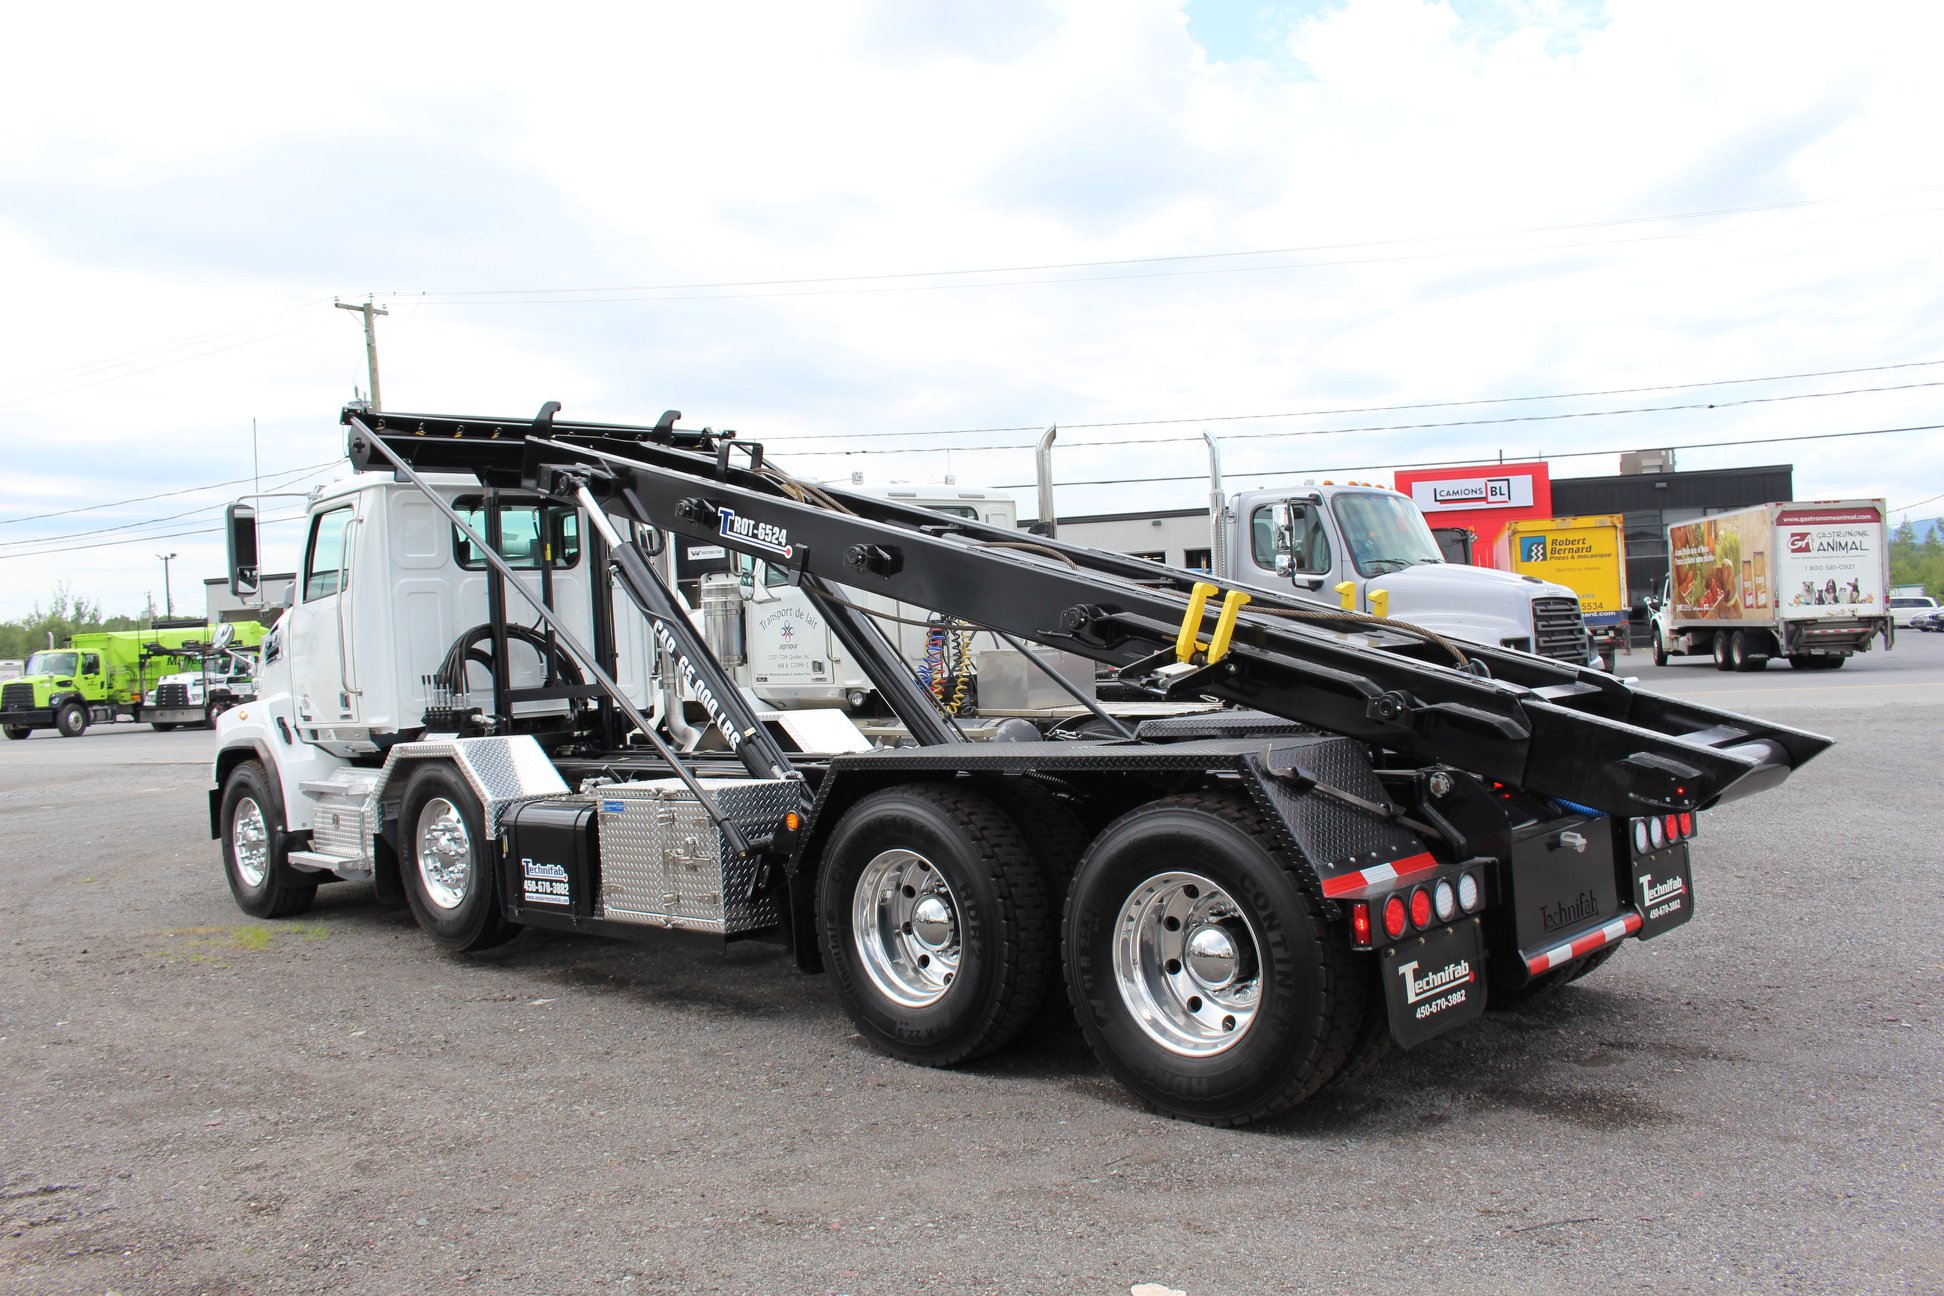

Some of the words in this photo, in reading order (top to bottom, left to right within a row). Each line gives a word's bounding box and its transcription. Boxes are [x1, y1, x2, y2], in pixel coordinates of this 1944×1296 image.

[1439, 487, 1483, 498] CAMIONS
[1490, 486, 1506, 497] BL
[1783, 514, 1872, 523] www.gastronomeanimal.com
[1816, 530, 1870, 539] GASTRONOME
[1551, 537, 1587, 547] Robert
[1816, 539, 1870, 554] ANIMAL
[1550, 545, 1592, 555] Bernard
[1825, 563, 1855, 571] 581-0921
[1581, 602, 1604, 611] 5534
[759, 607, 793, 631] Transport
[795, 607, 804, 620] de
[805, 612, 818, 630] lait
[779, 643, 798, 651] agropur
[522, 859, 566, 879] Technifab
[523, 880, 570, 895] 450-670-3882
[1639, 873, 1684, 907] Technifab
[1540, 889, 1598, 932] Technifab
[1398, 959, 1471, 1005] Technifab
[1415, 989, 1467, 1019] 450-670-3882
